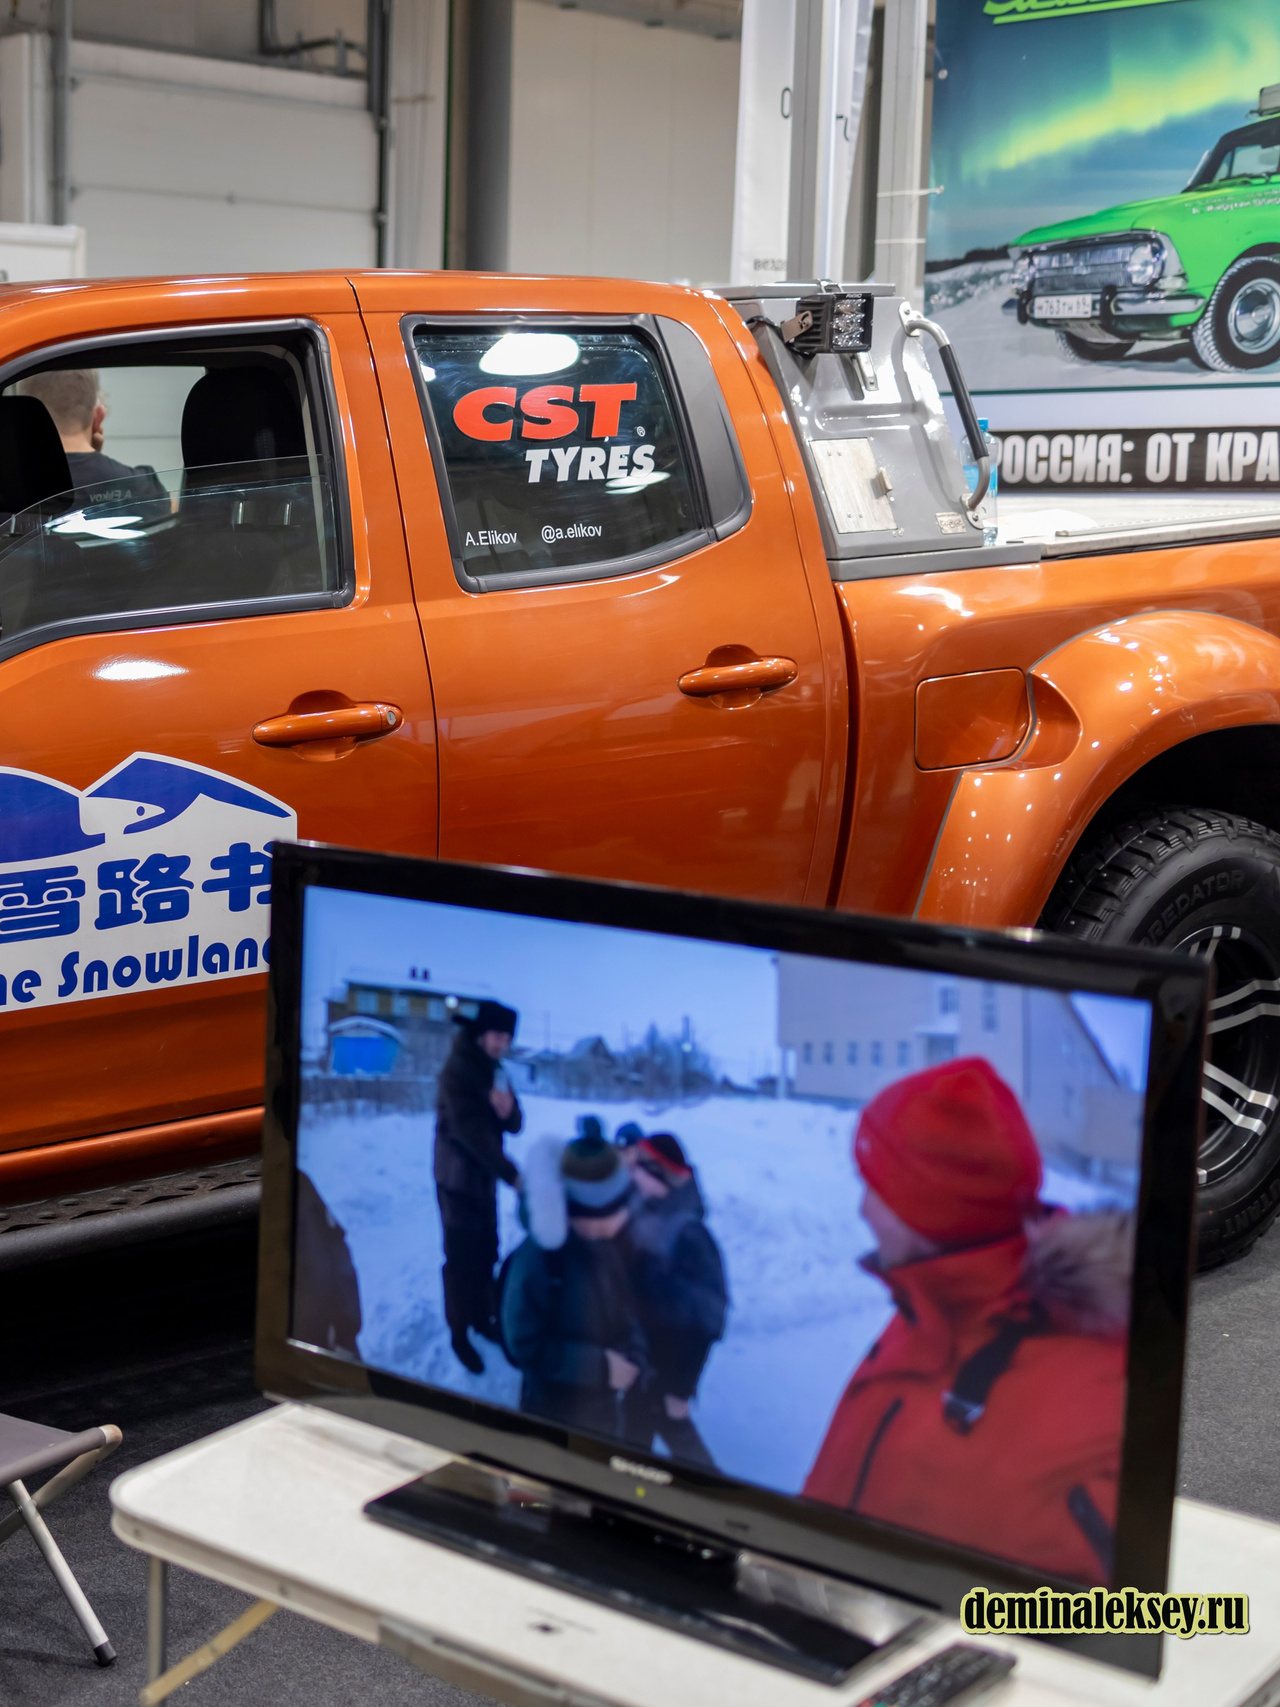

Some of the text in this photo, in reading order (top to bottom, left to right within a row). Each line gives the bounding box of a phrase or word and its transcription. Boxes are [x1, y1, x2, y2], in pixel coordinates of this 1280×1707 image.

[453, 383, 637, 442] CST
[525, 444, 656, 483] TYRES
[1145, 432, 1195, 483] ОТ
[465, 530, 518, 546] A.Elikov
[541, 523, 602, 543] @a.elikov
